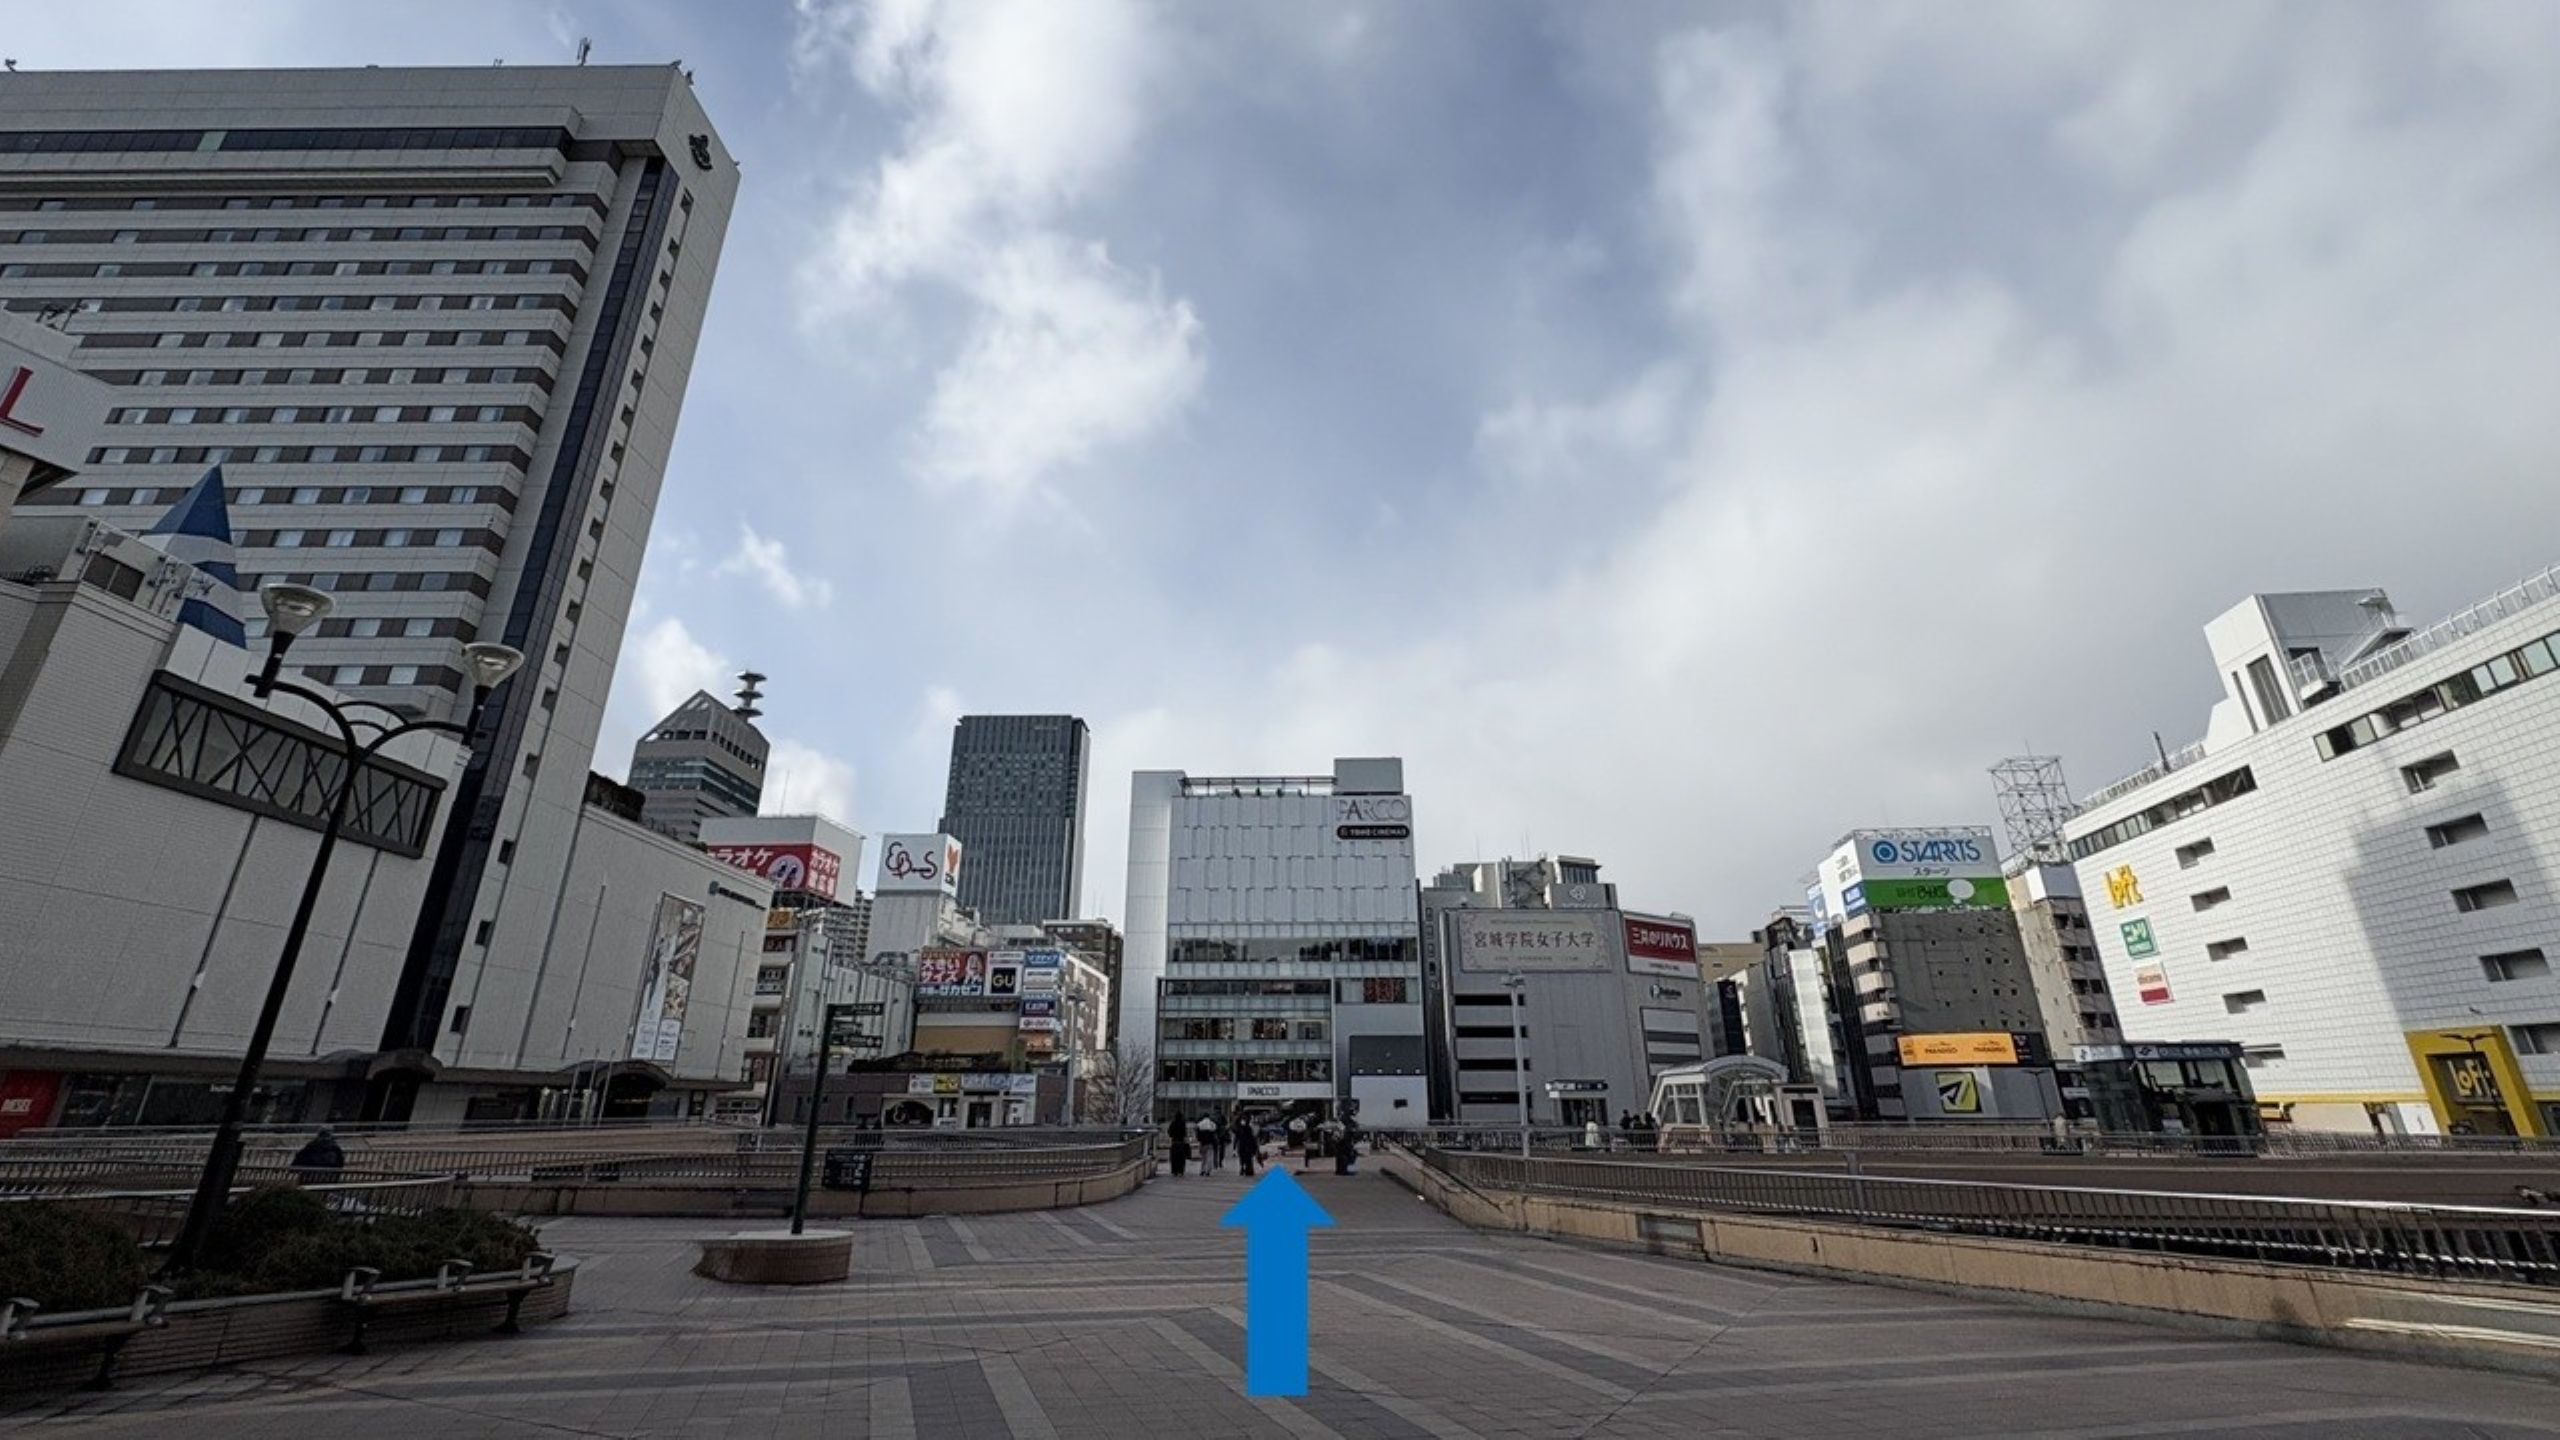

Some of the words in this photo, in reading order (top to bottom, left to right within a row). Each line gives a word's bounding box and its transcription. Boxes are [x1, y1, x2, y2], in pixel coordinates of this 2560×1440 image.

[1337, 799, 1409, 821] PARCO
[1901, 840, 1981, 862] STARTS
[1914, 867, 1950, 875] スターツ
[1474, 931, 1594, 948] 宮城学院女子大学
[1632, 927, 1689, 950] 三井のリハウス
[992, 975, 1015, 988] GU
